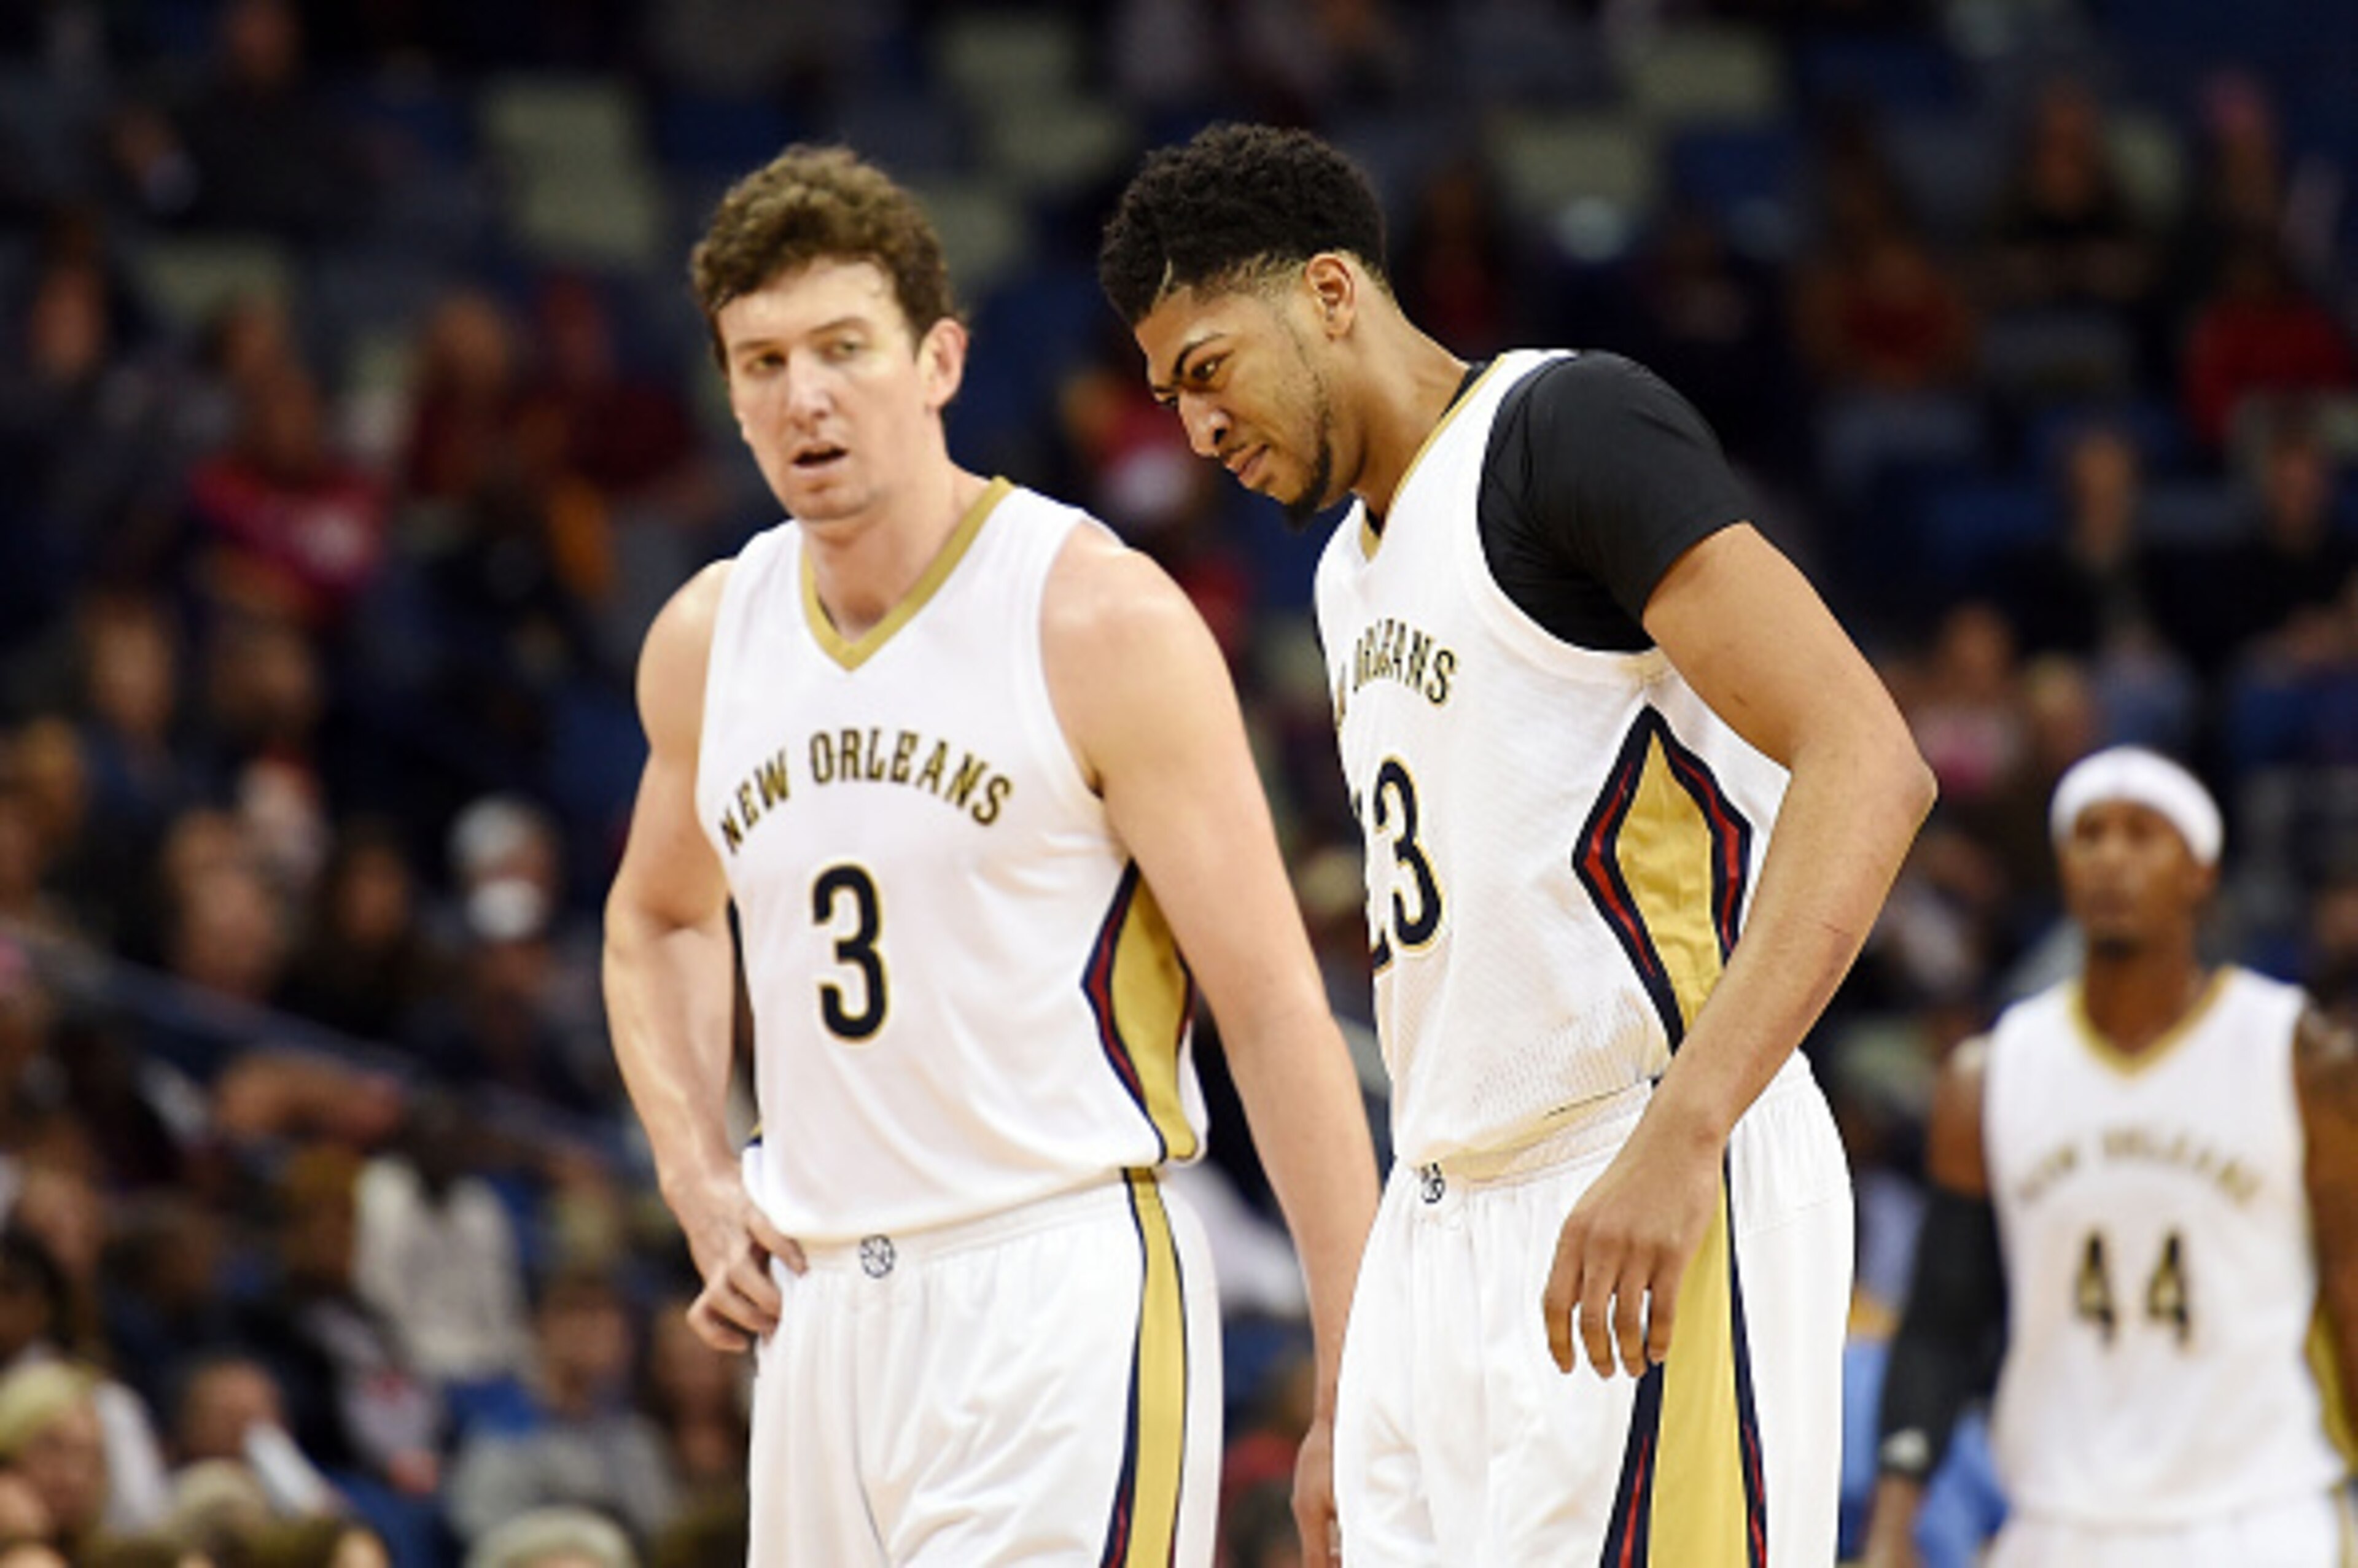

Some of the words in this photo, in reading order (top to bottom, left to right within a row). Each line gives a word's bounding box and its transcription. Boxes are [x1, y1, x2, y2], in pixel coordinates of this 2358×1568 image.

[720, 748, 789, 856] NEW
[809, 727, 1012, 826] ORLEANS
[811, 863, 888, 1044] 3
[2074, 1227, 2190, 1351] 44
